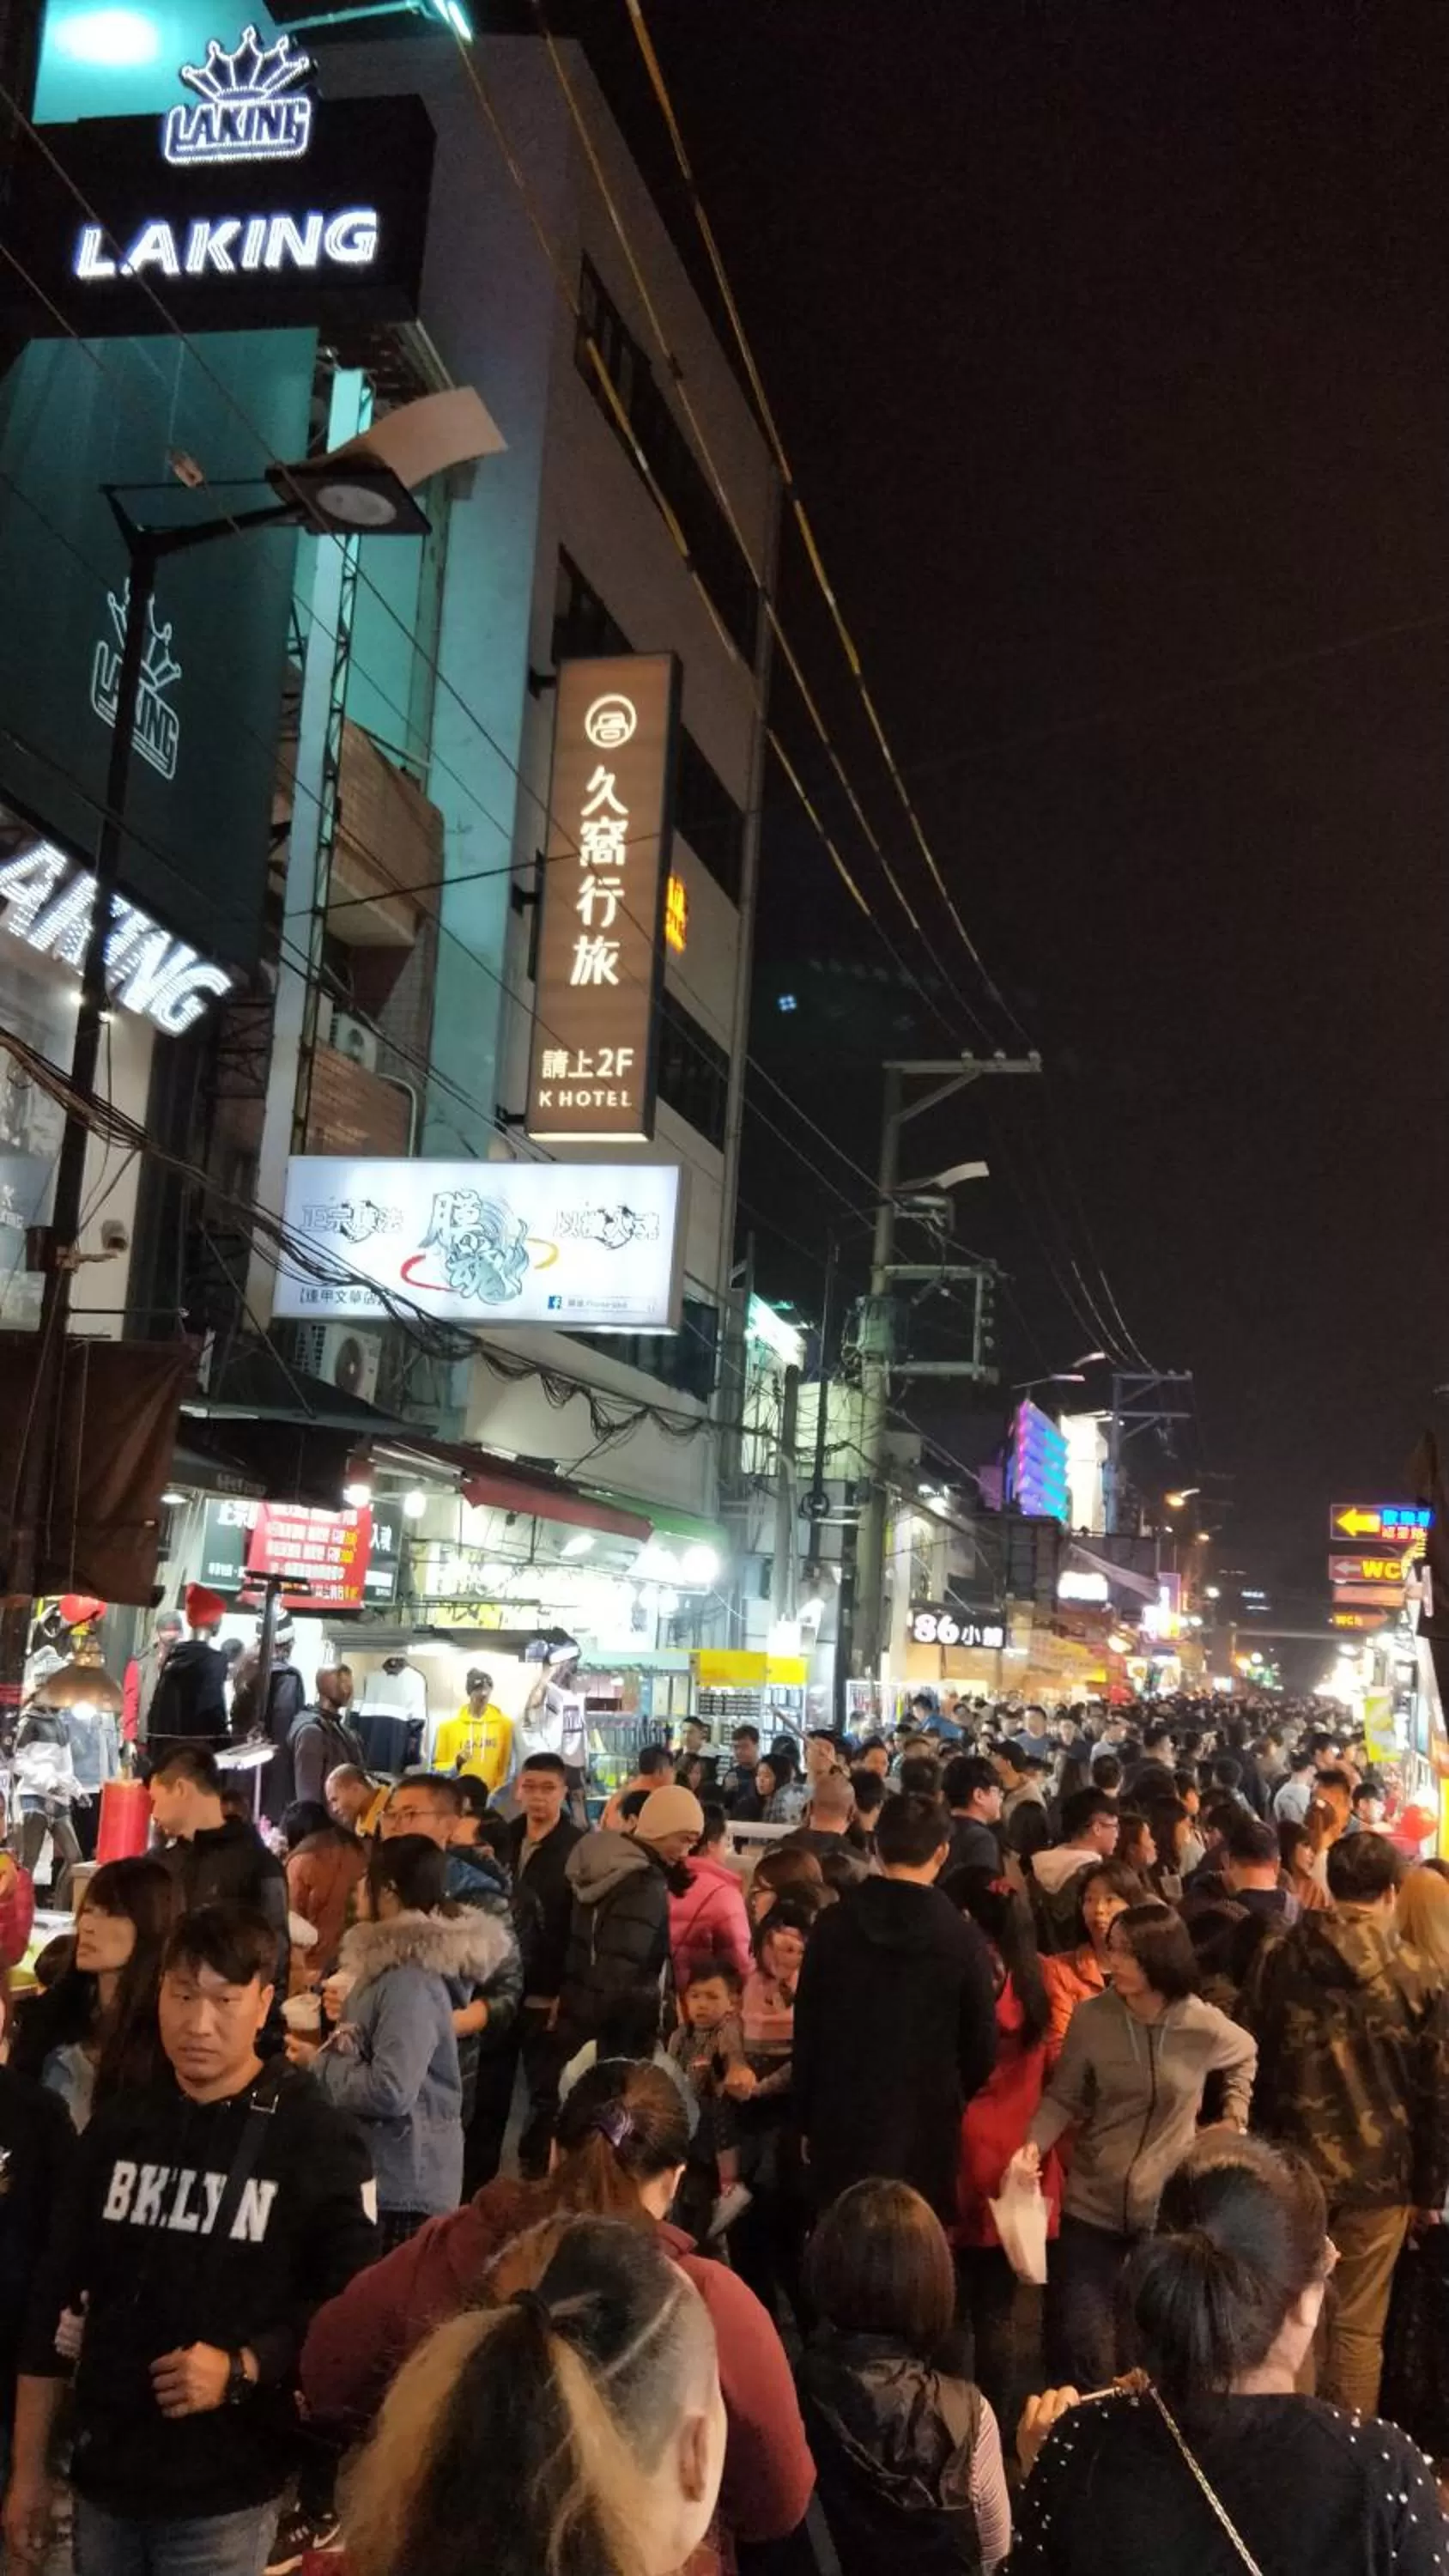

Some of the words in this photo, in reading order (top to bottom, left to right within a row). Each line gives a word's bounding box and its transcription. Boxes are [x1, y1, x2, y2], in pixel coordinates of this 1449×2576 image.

[165, 97, 311, 164] LAKING
[76, 211, 377, 279] LAKING
[570, 765, 629, 986] 久窩行旅
[542, 1048, 634, 1078] 請上2F
[539, 1091, 552, 1107] K
[559, 1091, 633, 1107] HOTEL
